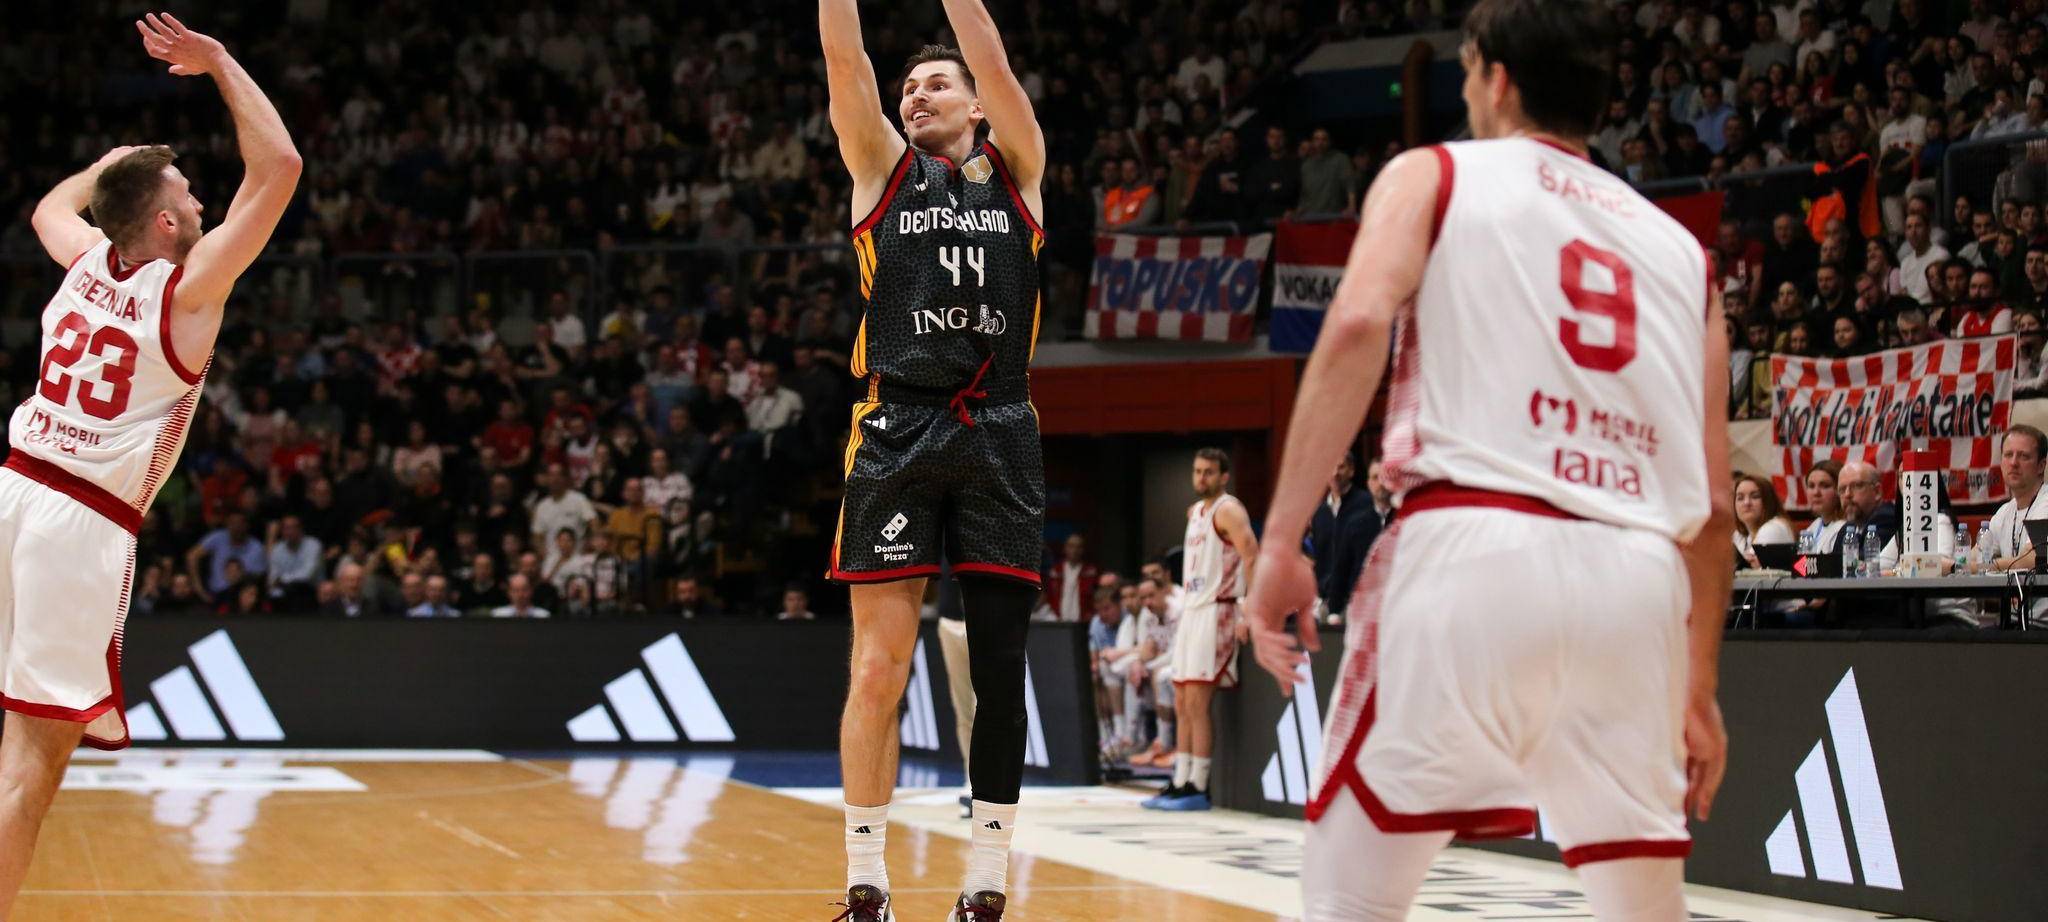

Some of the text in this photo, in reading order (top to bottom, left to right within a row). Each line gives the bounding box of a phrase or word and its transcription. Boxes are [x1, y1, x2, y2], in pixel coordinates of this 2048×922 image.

[900, 207, 1010, 234] DEUTSCHLAND
[939, 246, 984, 287] 44
[1095, 256, 1259, 312] TOPUSKO
[1281, 274, 1342, 302] VOKA
[1558, 239, 1637, 373] 9
[911, 307, 969, 335] ING
[40, 311, 139, 421] 23
[56, 422, 101, 445] MOBIL
[1905, 475, 1911, 490] 4
[1920, 474, 1932, 490] 4
[1906, 496, 1911, 511] 3
[1920, 495, 1931, 511] 3
[1906, 516, 1911, 532] 2
[1921, 515, 1932, 531] 2
[874, 542, 914, 554] Domino's
[1907, 537, 1910, 552] 1
[1922, 536, 1929, 552] 1
[883, 553, 908, 562] Pizza
